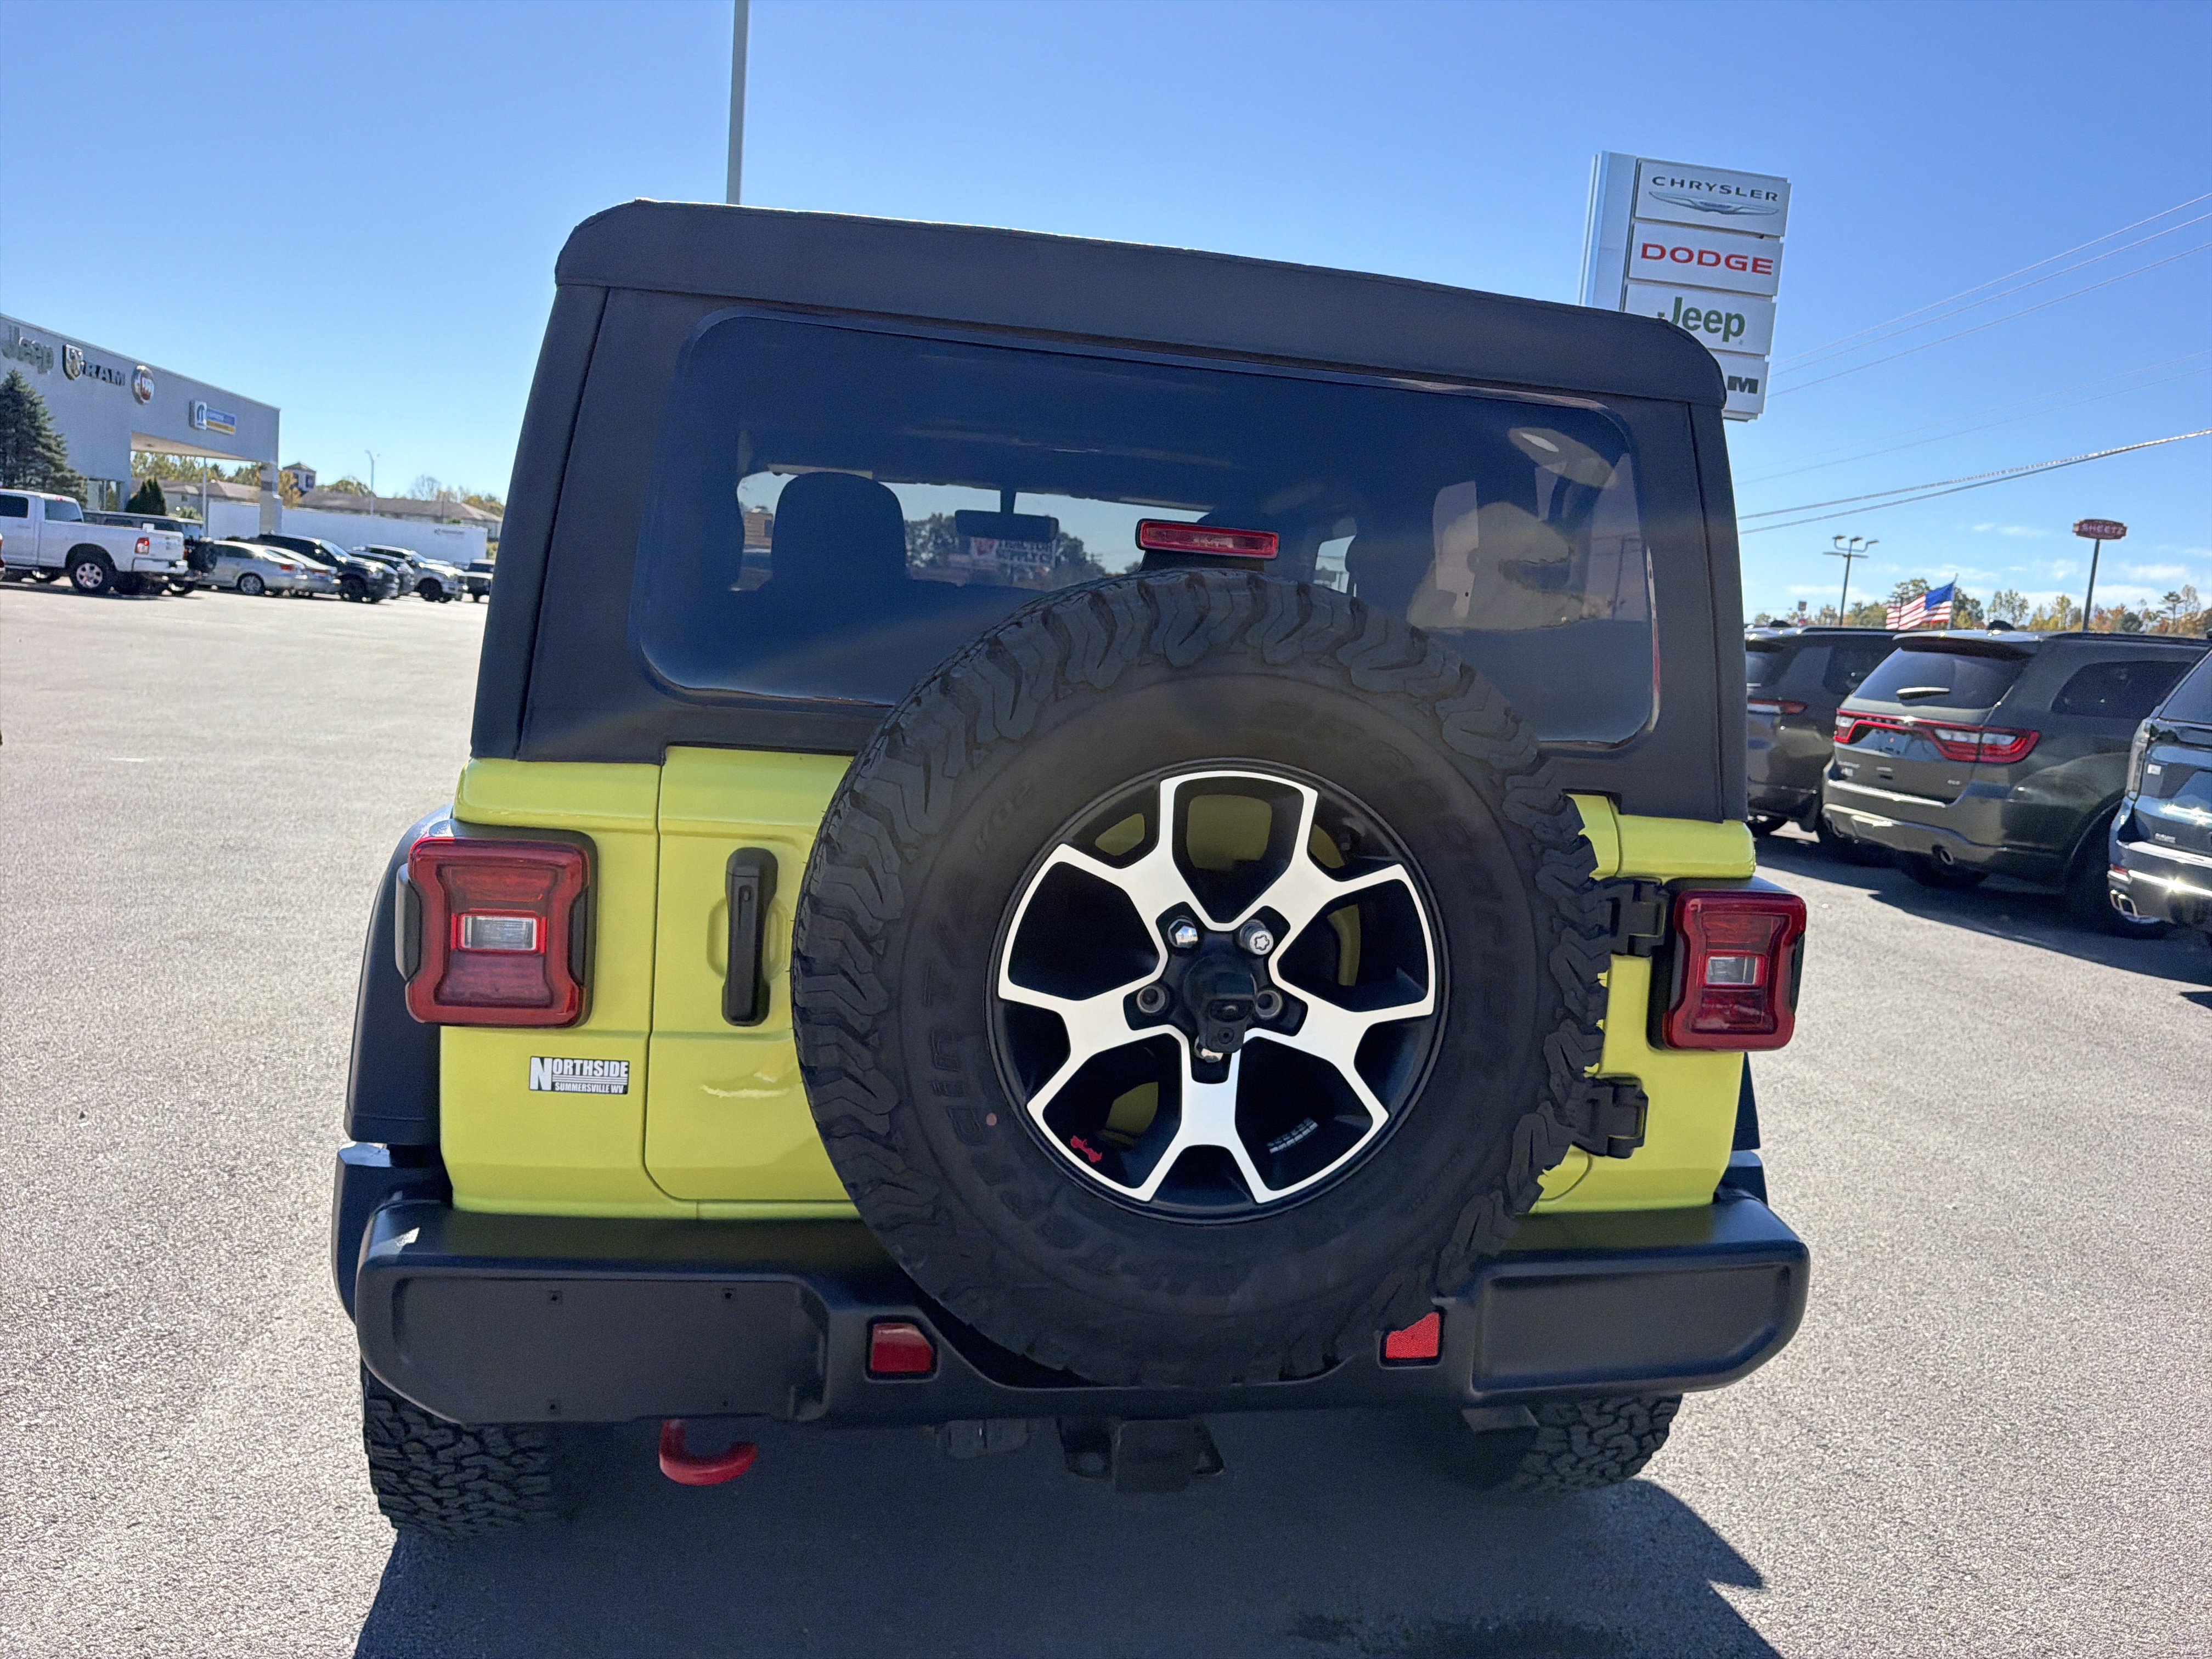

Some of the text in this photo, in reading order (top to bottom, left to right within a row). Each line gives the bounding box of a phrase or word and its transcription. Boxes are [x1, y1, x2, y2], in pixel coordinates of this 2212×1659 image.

[1651, 176, 1779, 201] CHRYSLER
[1640, 242, 1774, 275] DODGE
[1657, 296, 1746, 342] Jeep
[2, 325, 54, 375] Jeep
[82, 360, 126, 386] RAM
[529, 1057, 629, 1091] NORTHSIDE
[555, 1082, 624, 1093] SUMMERSVILLE WV
